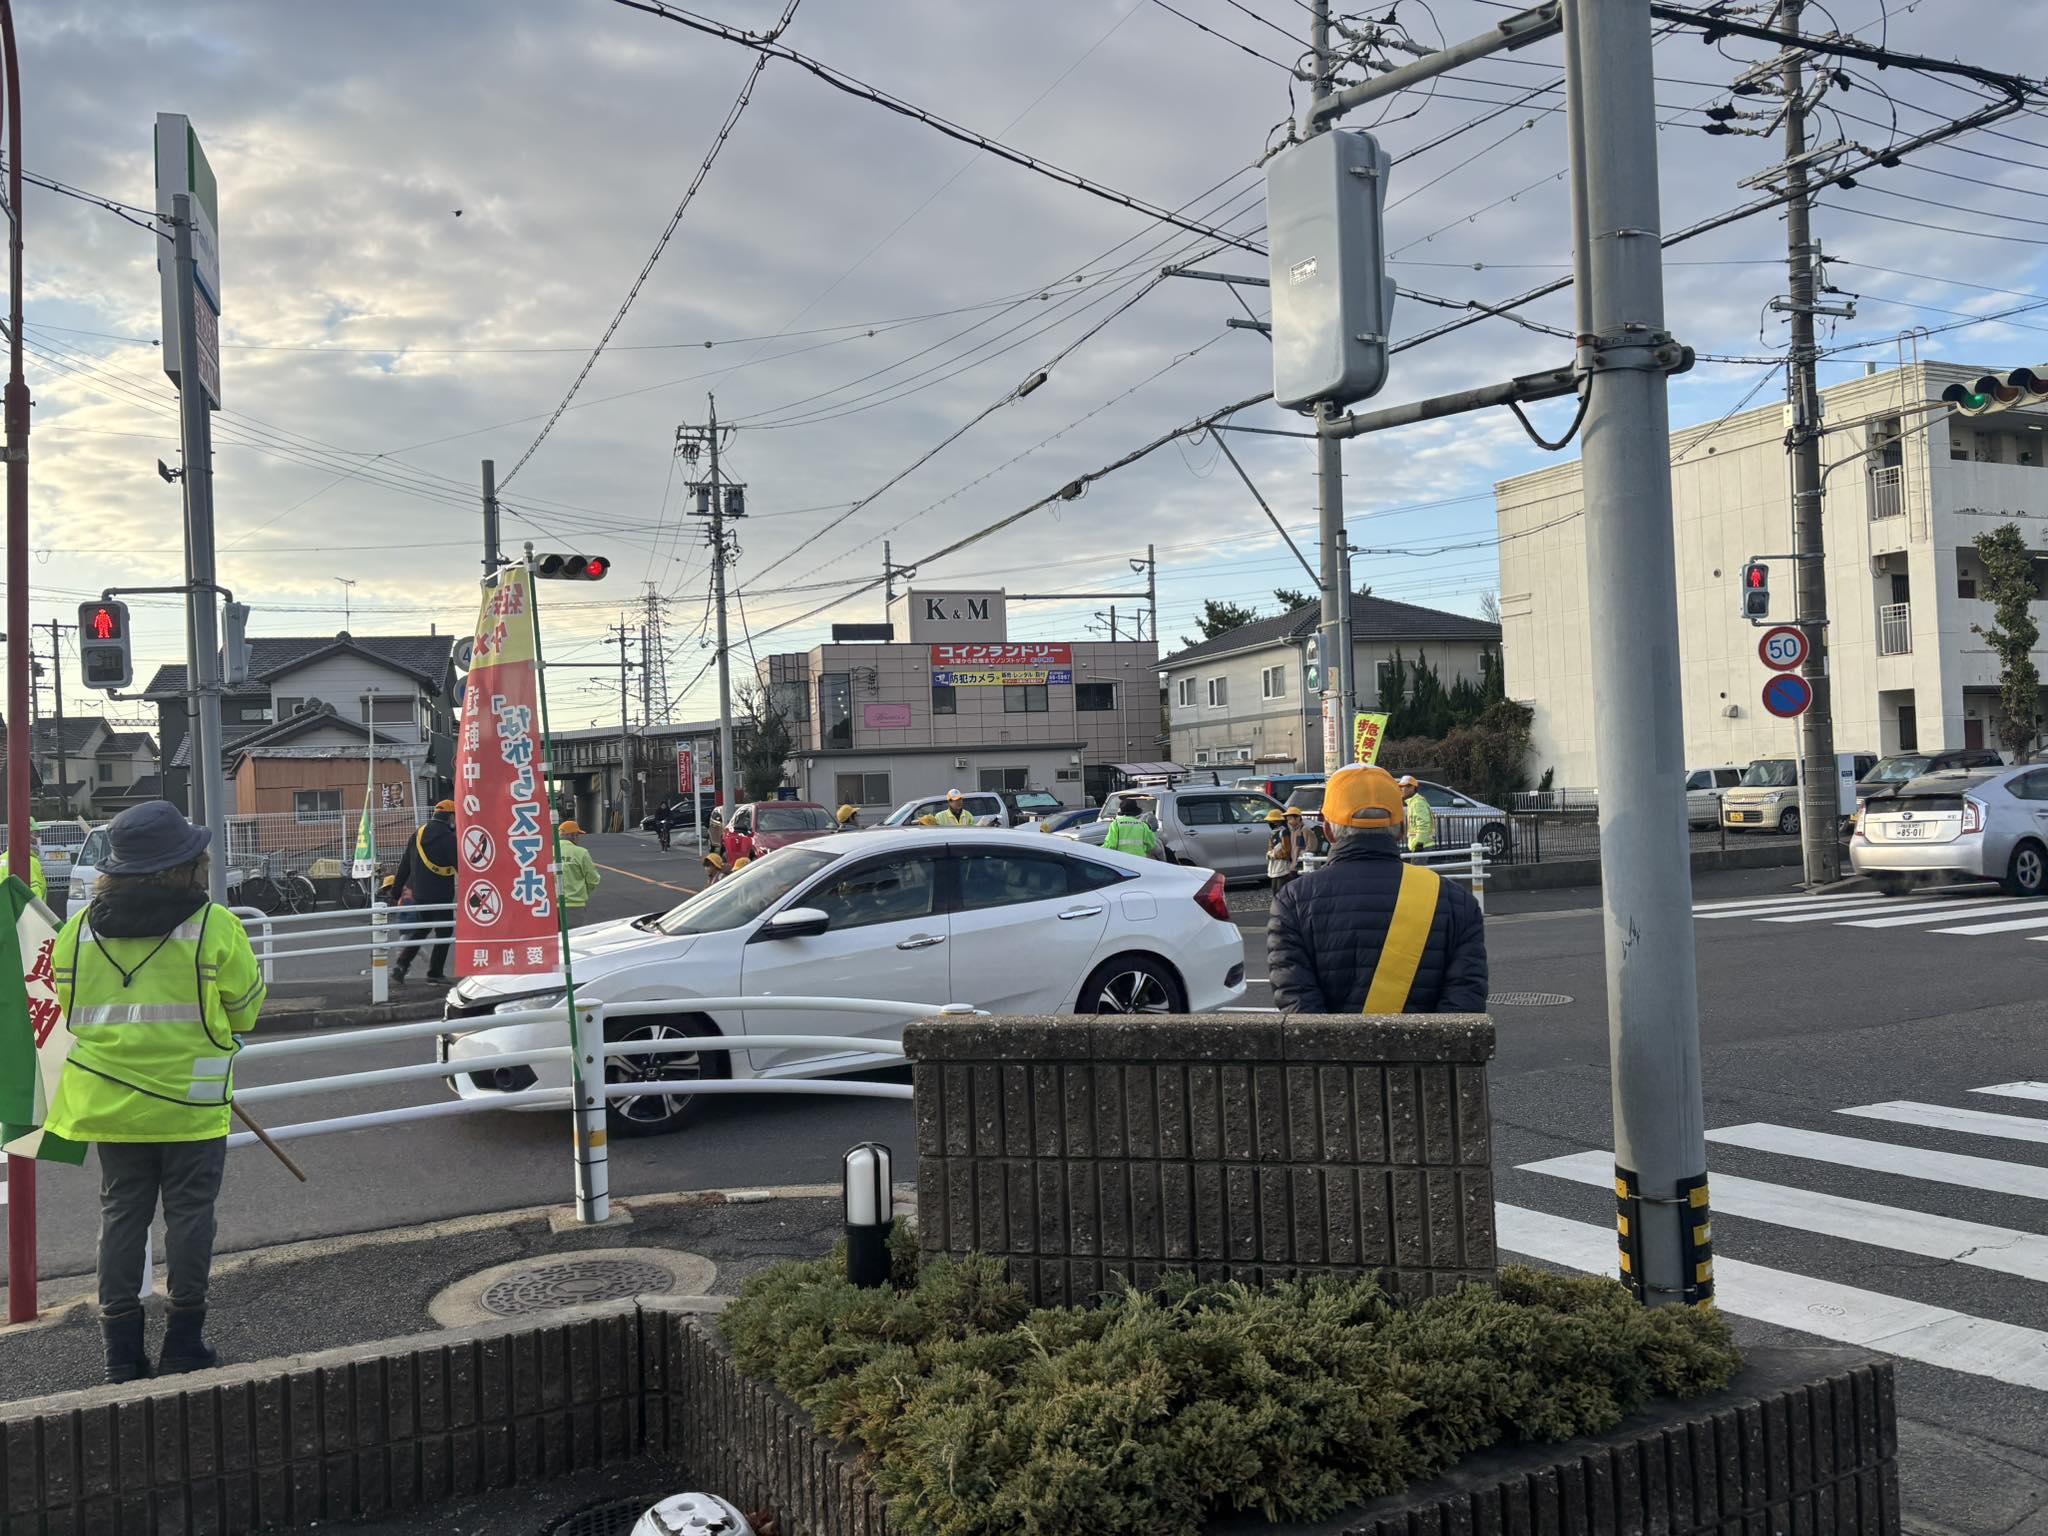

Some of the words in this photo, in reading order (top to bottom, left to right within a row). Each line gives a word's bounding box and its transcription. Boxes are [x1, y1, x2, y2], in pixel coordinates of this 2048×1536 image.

[926, 598, 947, 620] K
[953, 609, 961, 620] &
[967, 598, 989, 620] M
[939, 645, 1063, 657] コインランドリー
[1769, 638, 1798, 659] 50
